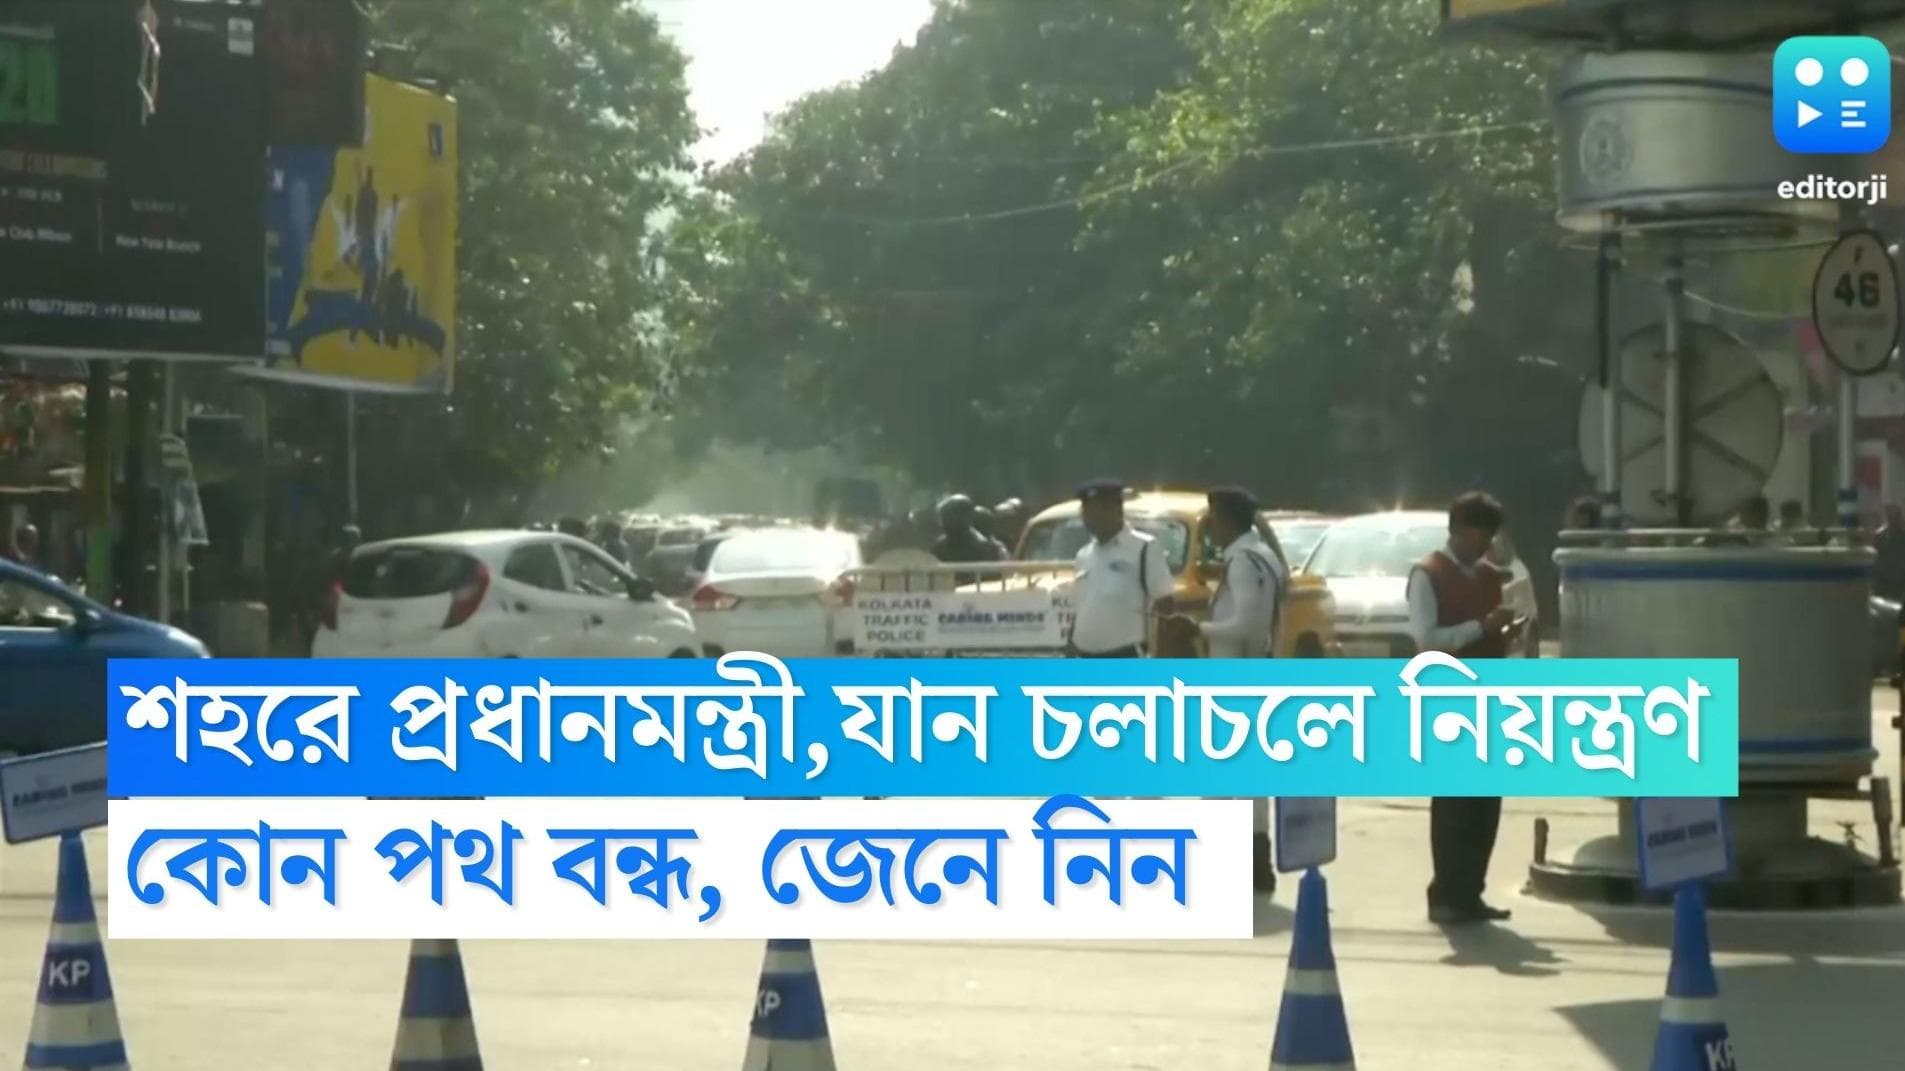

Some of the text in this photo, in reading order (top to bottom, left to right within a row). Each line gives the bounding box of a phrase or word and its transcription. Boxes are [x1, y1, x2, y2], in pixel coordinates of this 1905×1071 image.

[1834, 272, 1880, 307] 46
[858, 598, 932, 610] KOLKATA
[864, 614, 929, 626] TRAFFIC
[867, 631, 925, 642] POLICE
[48, 959, 91, 987] KP
